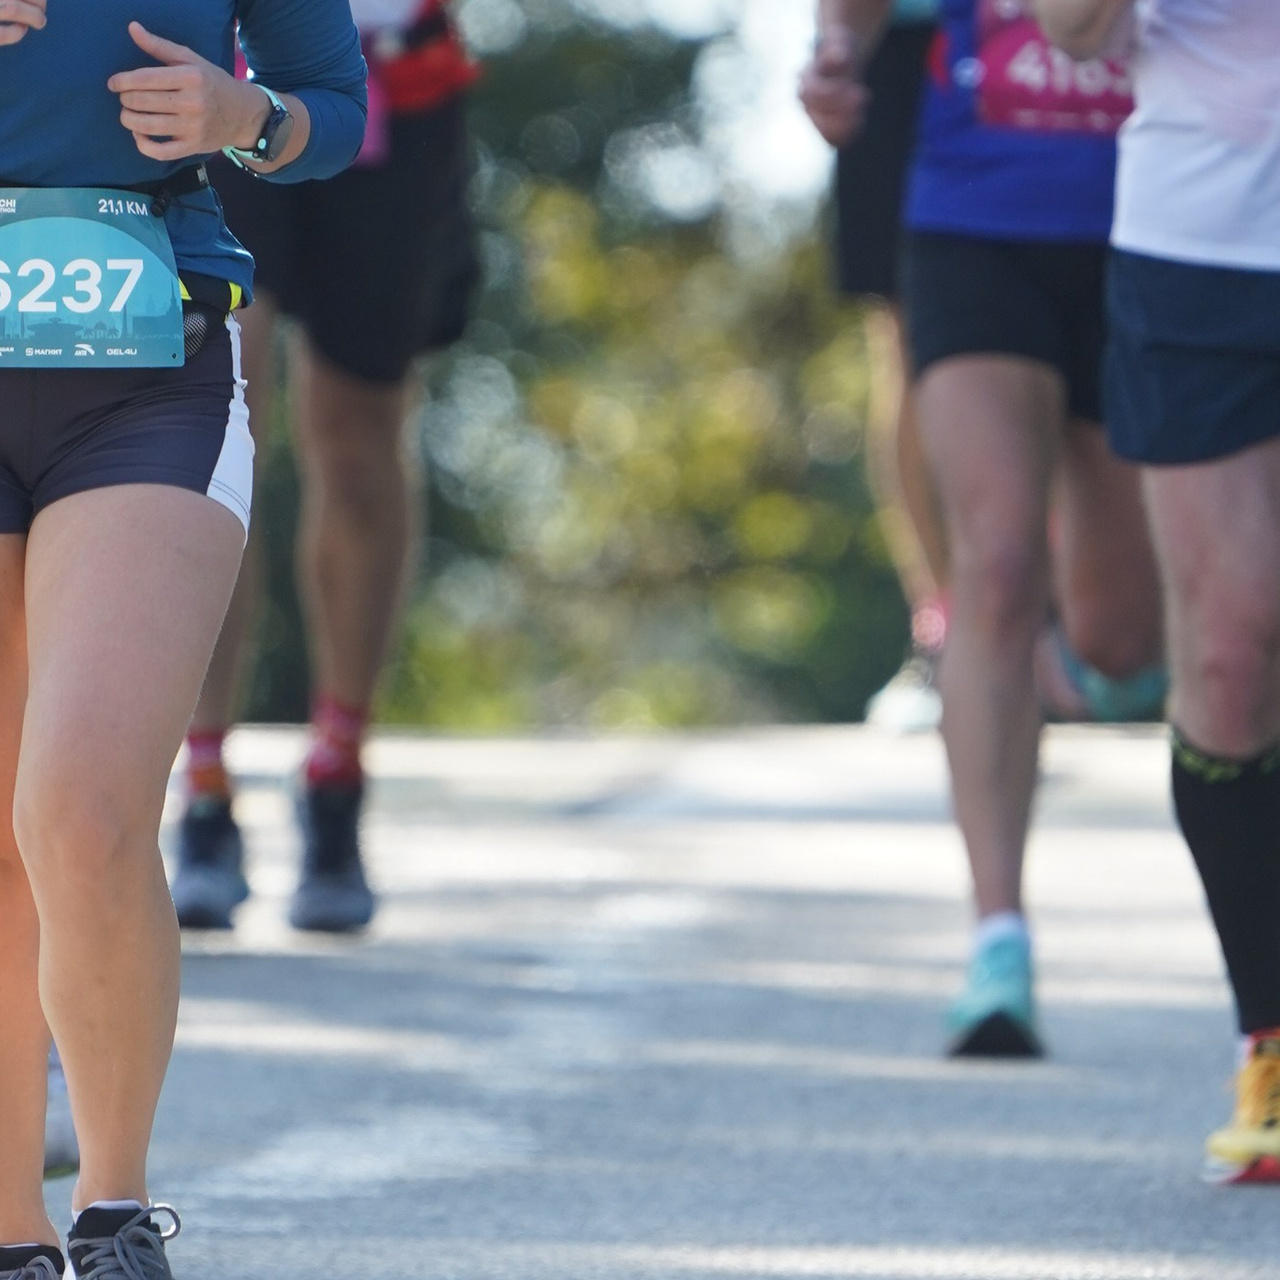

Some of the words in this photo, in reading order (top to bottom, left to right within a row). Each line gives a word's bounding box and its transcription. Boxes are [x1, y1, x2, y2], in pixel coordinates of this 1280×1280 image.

[98, 198, 123, 216] 21,1
[125, 200, 149, 216] KM
[106, 348, 138, 356] GEL4U
